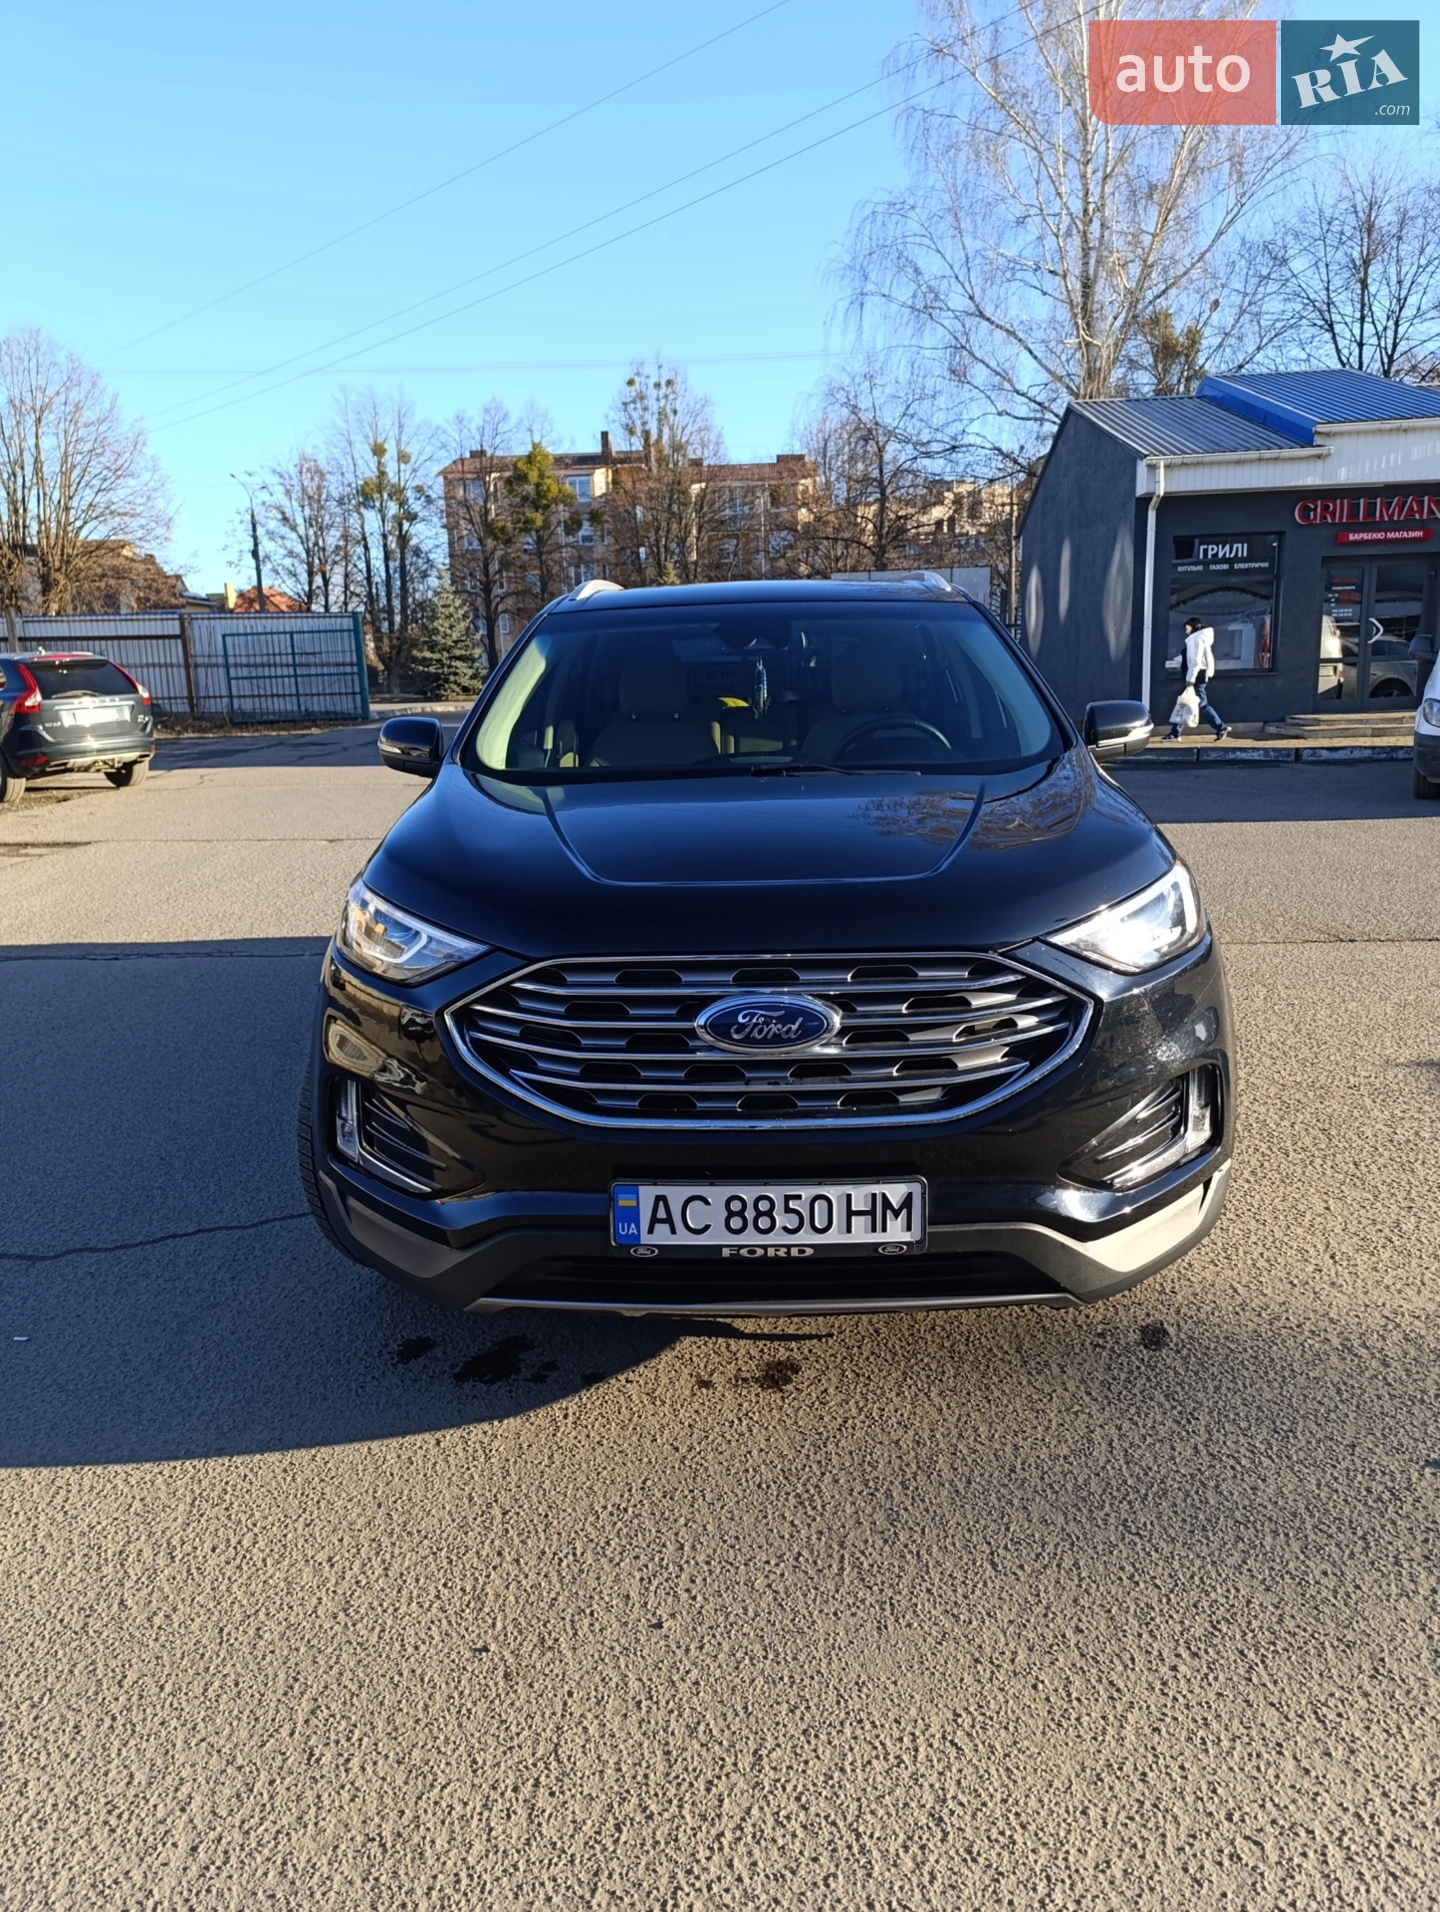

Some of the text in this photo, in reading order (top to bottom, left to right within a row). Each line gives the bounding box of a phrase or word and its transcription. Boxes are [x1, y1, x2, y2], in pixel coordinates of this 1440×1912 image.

[1295, 496, 1440, 525] GRILLMAN
[1348, 530, 1424, 541] БАРБЕКЮ МАГАЗИН
[1199, 542, 1248, 560] ГРИЛІ
[731, 1010, 803, 1039] Ford
[646, 1191, 914, 1236] AC 8850 HM
[618, 1222, 638, 1236] UA
[721, 1246, 815, 1258] FORD
